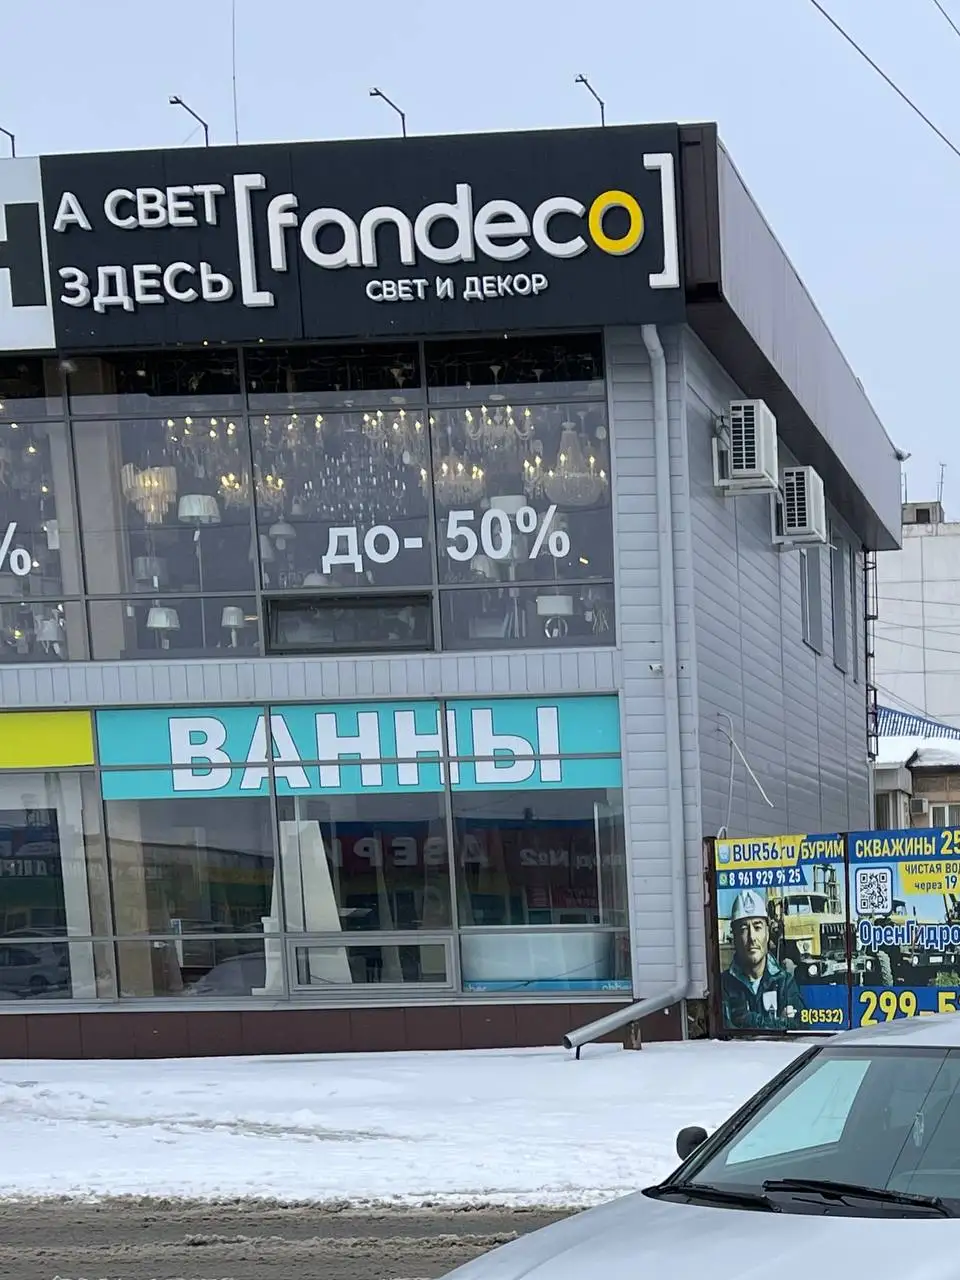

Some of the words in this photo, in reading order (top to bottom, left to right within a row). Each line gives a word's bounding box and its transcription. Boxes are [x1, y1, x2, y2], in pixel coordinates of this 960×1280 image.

[53, 191, 92, 232] А
[104, 184, 226, 230] СВЕТ
[58, 261, 234, 314] ЗДЕСЬ
[365, 279, 429, 302] СВЕТ
[436, 275, 455, 300] И
[463, 273, 549, 301] ДЕКОР
[446, 504, 571, 562] 50%
[168, 705, 563, 792] ВАННЫ
[801, 840, 844, 859] БУРИМ
[855, 837, 936, 858] СКВАЖИНЫ
[729, 873, 735, 886] 8
[738, 872, 753, 886] 961
[756, 870, 773, 885] 929
[788, 868, 801, 883] 25
[904, 865, 942, 875] ЧИСТАЯ
[914, 883, 943, 892] через
[945, 875, 958, 890] 19
[800, 1009, 843, 1025] 8(3532)
